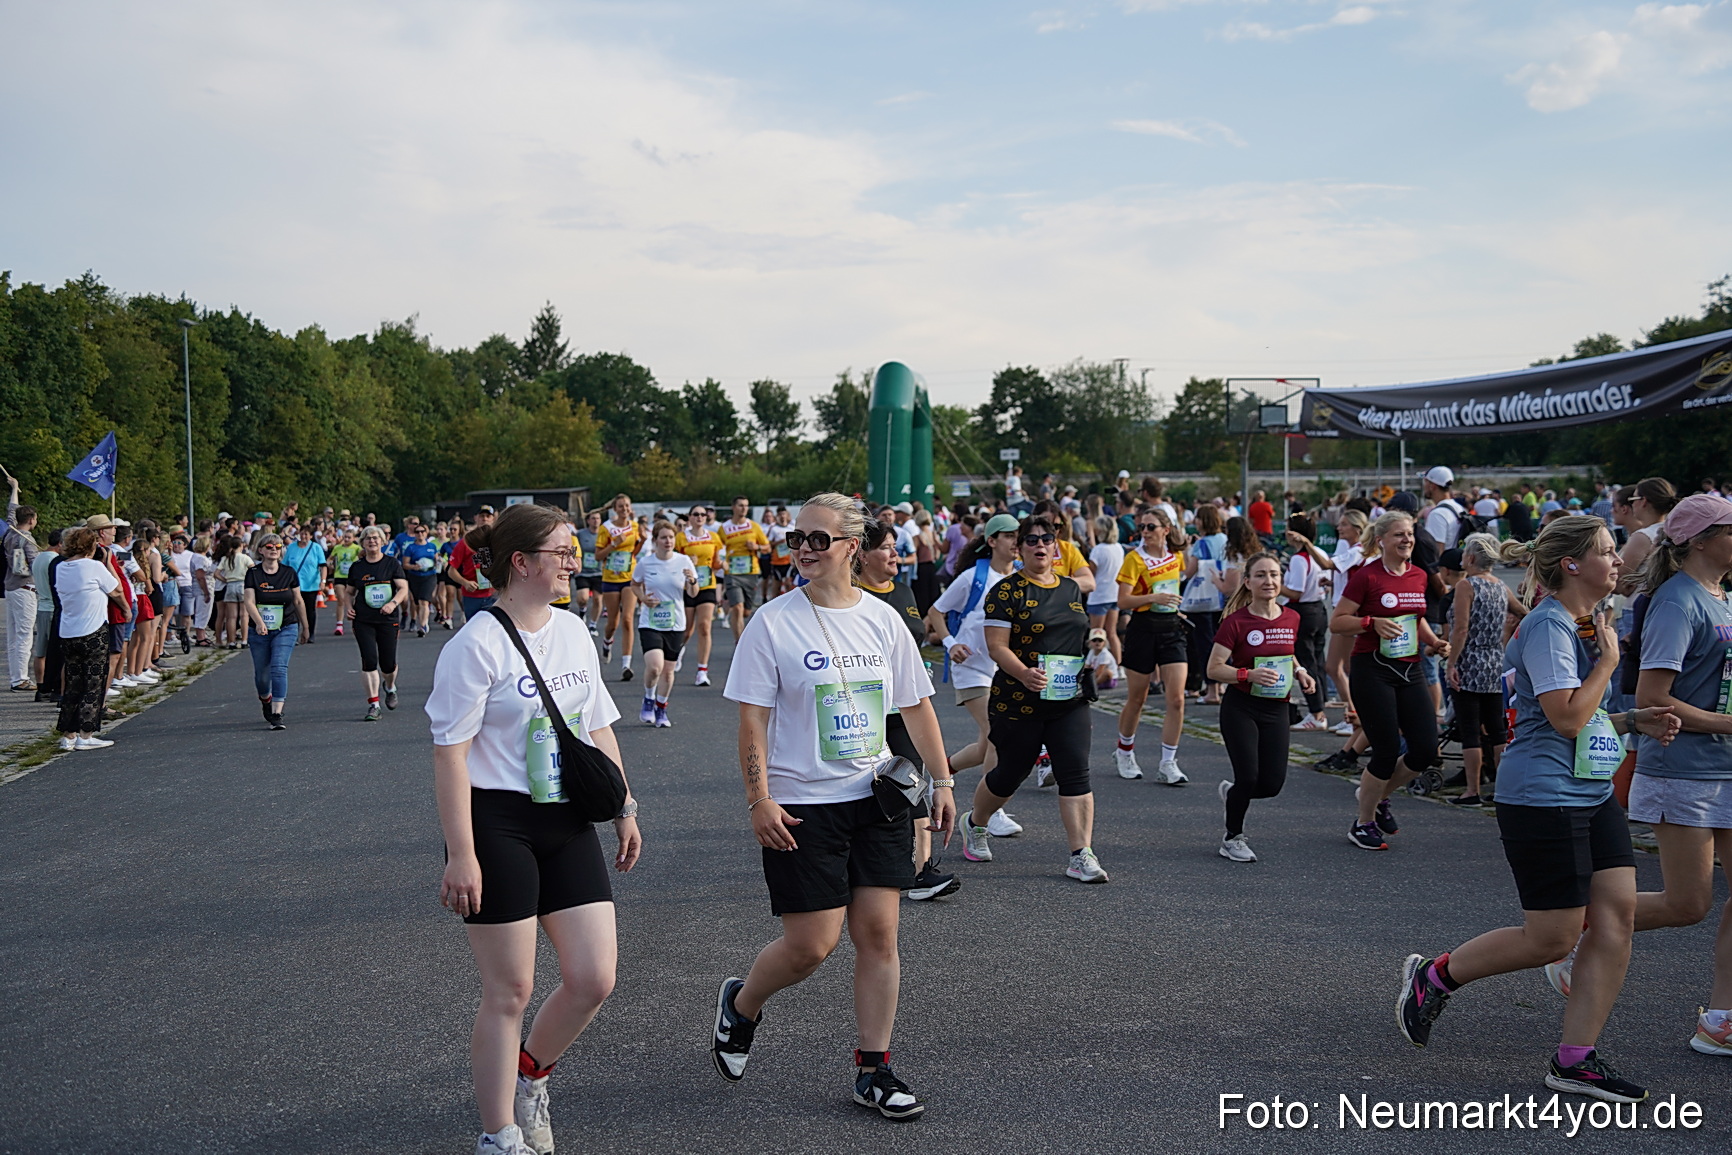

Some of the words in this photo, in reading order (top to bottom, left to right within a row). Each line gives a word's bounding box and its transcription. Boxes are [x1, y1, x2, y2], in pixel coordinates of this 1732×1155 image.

[1358, 405, 1391, 430] Hier
[1390, 401, 1460, 437] gewinnt
[1460, 399, 1497, 426] das
[1499, 381, 1641, 423] Miteinander.
[1149, 569, 1165, 578] MAX
[1053, 673, 1077, 684] 2089
[833, 712, 869, 731] 1009
[829, 734, 848, 742] Mona
[1589, 735, 1619, 752] 2505
[550, 752, 563, 769] 10
